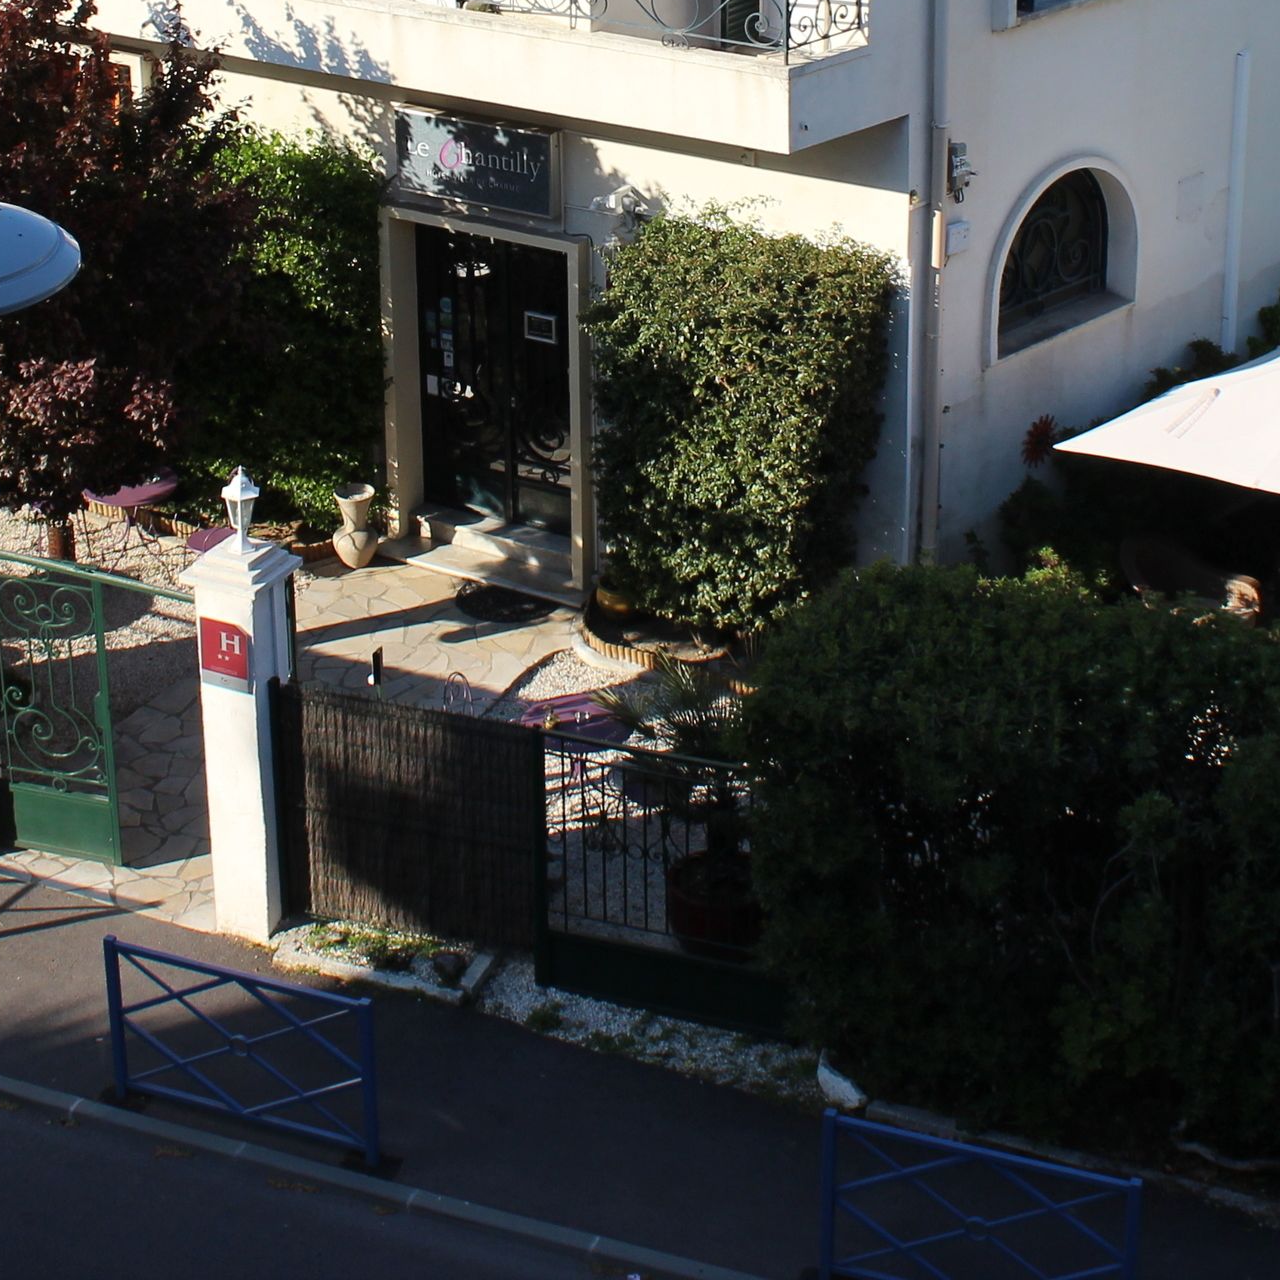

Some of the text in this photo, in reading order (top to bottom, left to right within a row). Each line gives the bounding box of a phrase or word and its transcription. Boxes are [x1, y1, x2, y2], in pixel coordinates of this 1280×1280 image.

[406, 137, 541, 182] Le Chantilly
[220, 632, 241, 655] H
